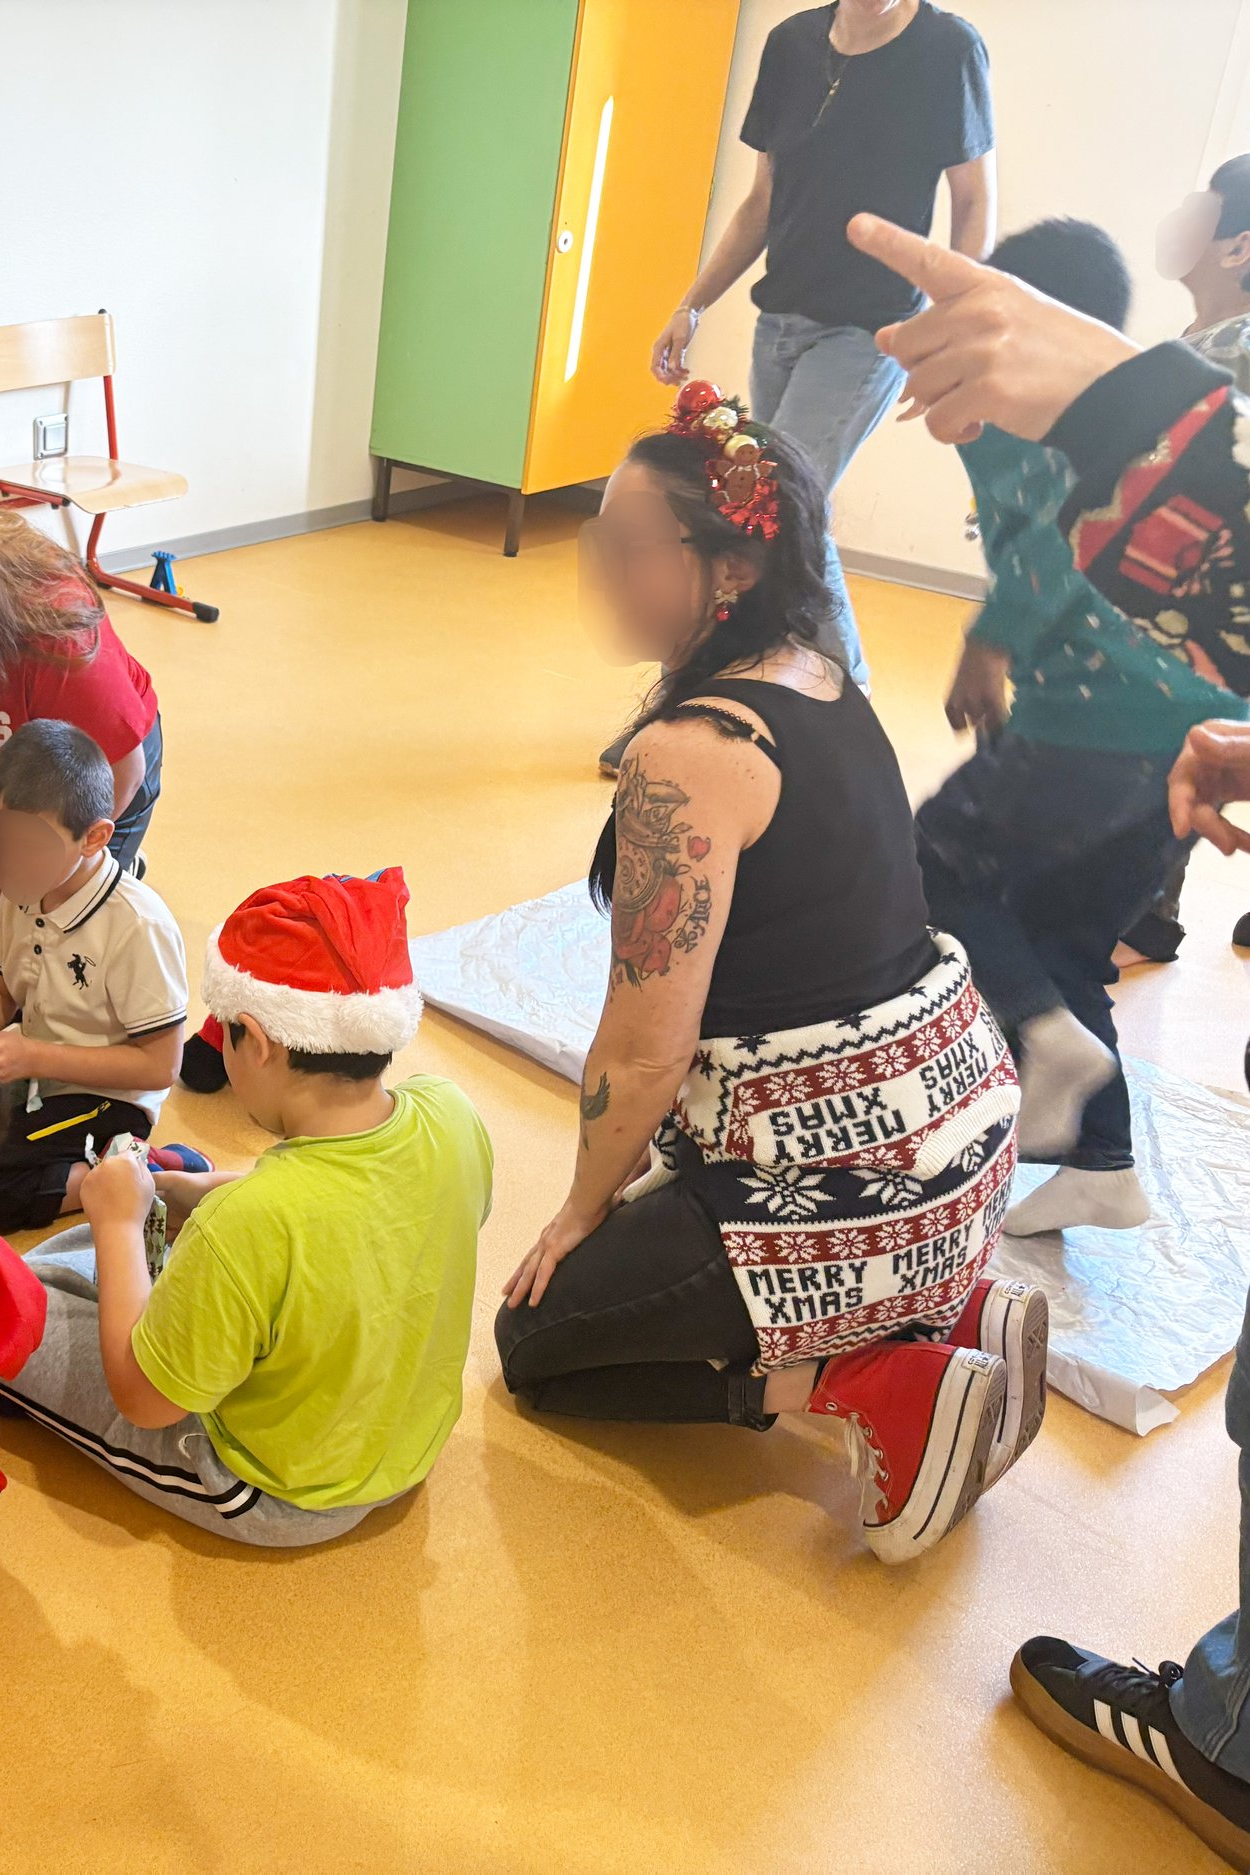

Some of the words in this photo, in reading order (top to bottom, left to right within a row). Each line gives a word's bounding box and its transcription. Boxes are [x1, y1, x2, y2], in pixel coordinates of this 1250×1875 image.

[919, 1030, 979, 1090] XMAS
[928, 1053, 989, 1118] MERRY
[769, 1086, 888, 1137] XMAS
[773, 1108, 907, 1164] MERRY
[747, 1260, 868, 1297] MERRY
[893, 1219, 975, 1275] MERRY
[765, 1287, 864, 1325] XMAS
[898, 1245, 969, 1294] XMAS
